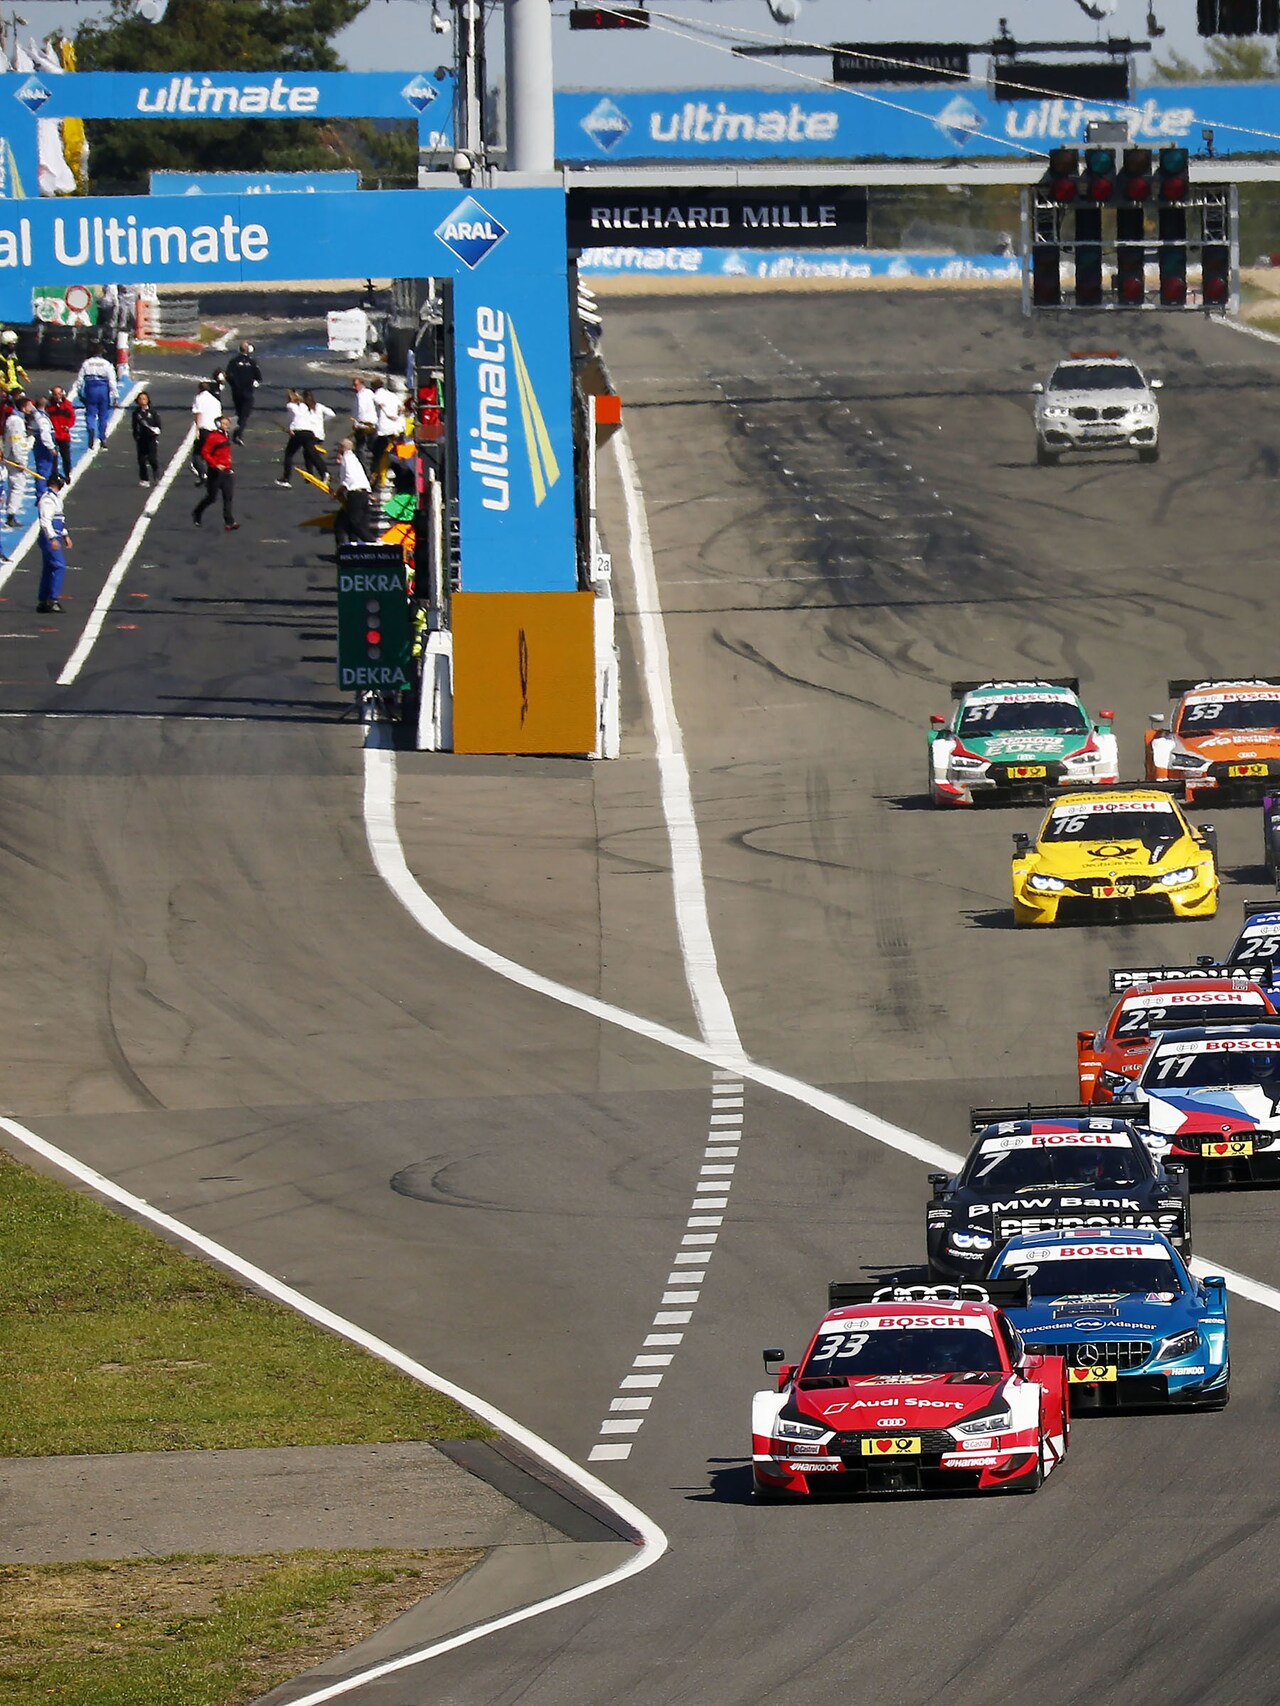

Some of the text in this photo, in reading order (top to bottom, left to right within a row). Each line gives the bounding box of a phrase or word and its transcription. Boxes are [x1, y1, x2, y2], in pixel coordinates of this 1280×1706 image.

[137, 76, 320, 113] ultimate
[650, 101, 840, 142] ultimate
[591, 205, 837, 229] RICHARD MILLE
[443, 221, 499, 242] ARAL
[54, 214, 269, 267] Ultimate
[467, 305, 510, 512] ultimate
[597, 556, 610, 572] 2a
[340, 575, 404, 592] DEKRA
[343, 667, 406, 685] DEKRA
[1003, 694, 1060, 702] BOSCH
[1223, 693, 1279, 701] BOSCH
[965, 704, 998, 722] 51
[1188, 704, 1223, 721] 53
[985, 743, 1065, 757] EDGE
[1092, 803, 1155, 811] BOSCH
[1053, 815, 1090, 835] 16
[1171, 994, 1242, 1003] BOSCH
[1119, 1008, 1167, 1032] 22
[1205, 1041, 1280, 1050] BOSCH
[1156, 1055, 1197, 1080] 11
[1031, 1134, 1112, 1145] BOSCH
[976, 1151, 1011, 1178] 7
[968, 1197, 1053, 1218] BMW
[1060, 1196, 1140, 1212] Bank
[1059, 1246, 1143, 1257] BOSCH
[878, 1316, 965, 1328] BOSCH
[1016, 1322, 1073, 1334] Mercedes
[1107, 1320, 1157, 1330] Adapter
[812, 1333, 870, 1361] 33
[851, 1397, 964, 1410] Audi Sport
[796, 1462, 839, 1472] Hankook
[954, 1456, 998, 1467] Hankook
